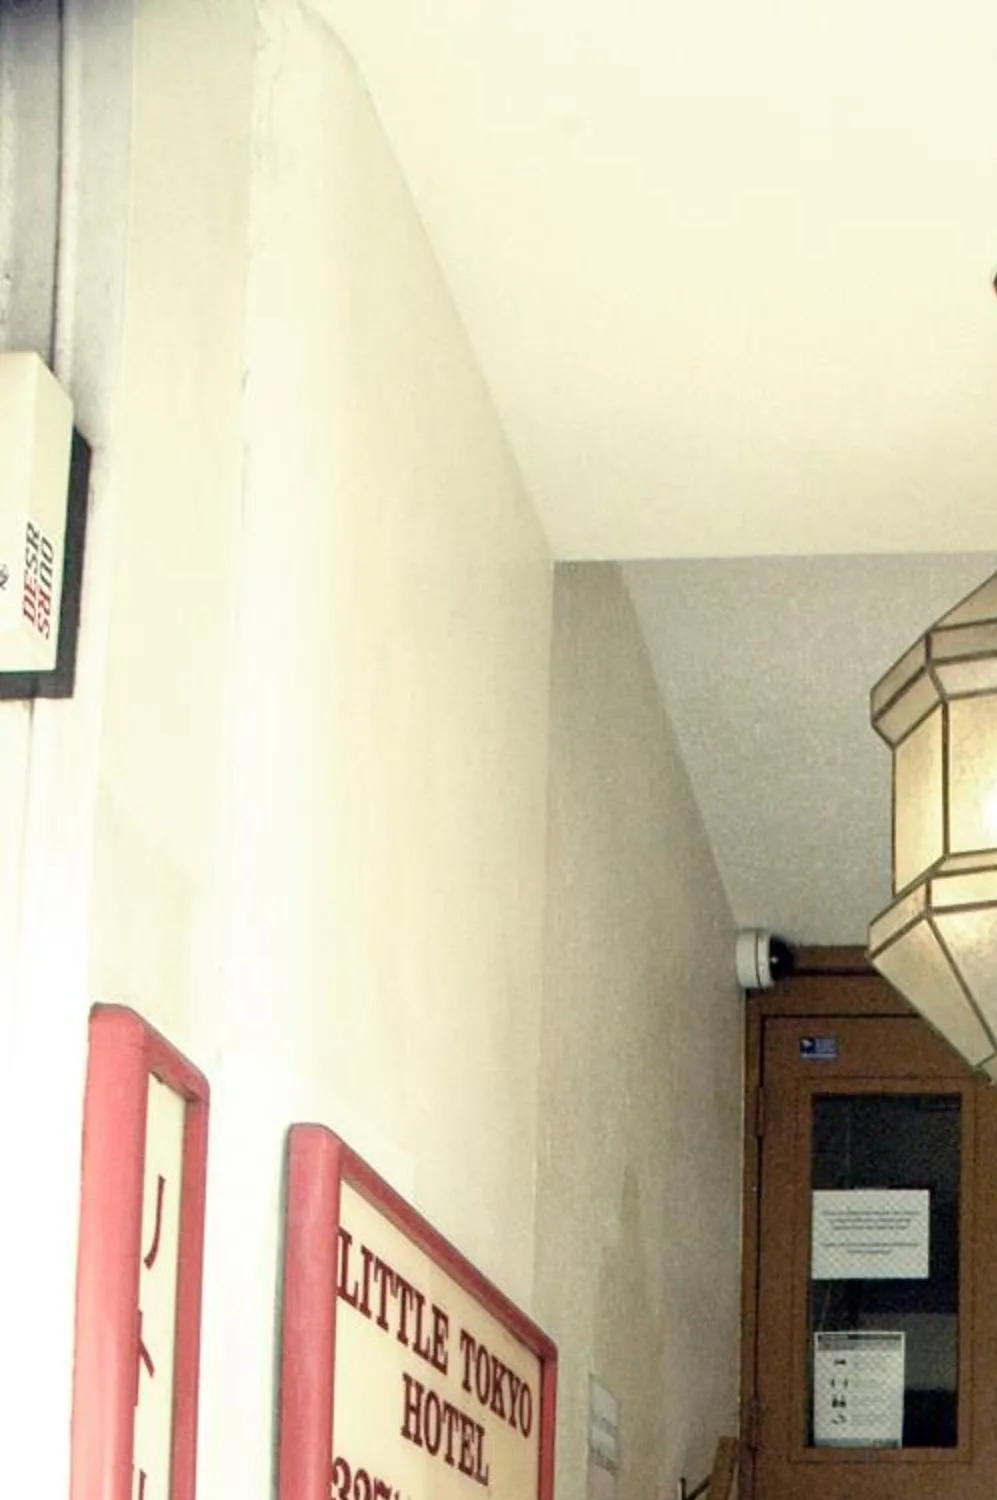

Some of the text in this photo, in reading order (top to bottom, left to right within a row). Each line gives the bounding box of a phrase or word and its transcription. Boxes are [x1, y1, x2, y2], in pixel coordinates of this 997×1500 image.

[336, 1228, 534, 1441] LITTLE TOKYO
[400, 1373, 489, 1487] HOTEL
